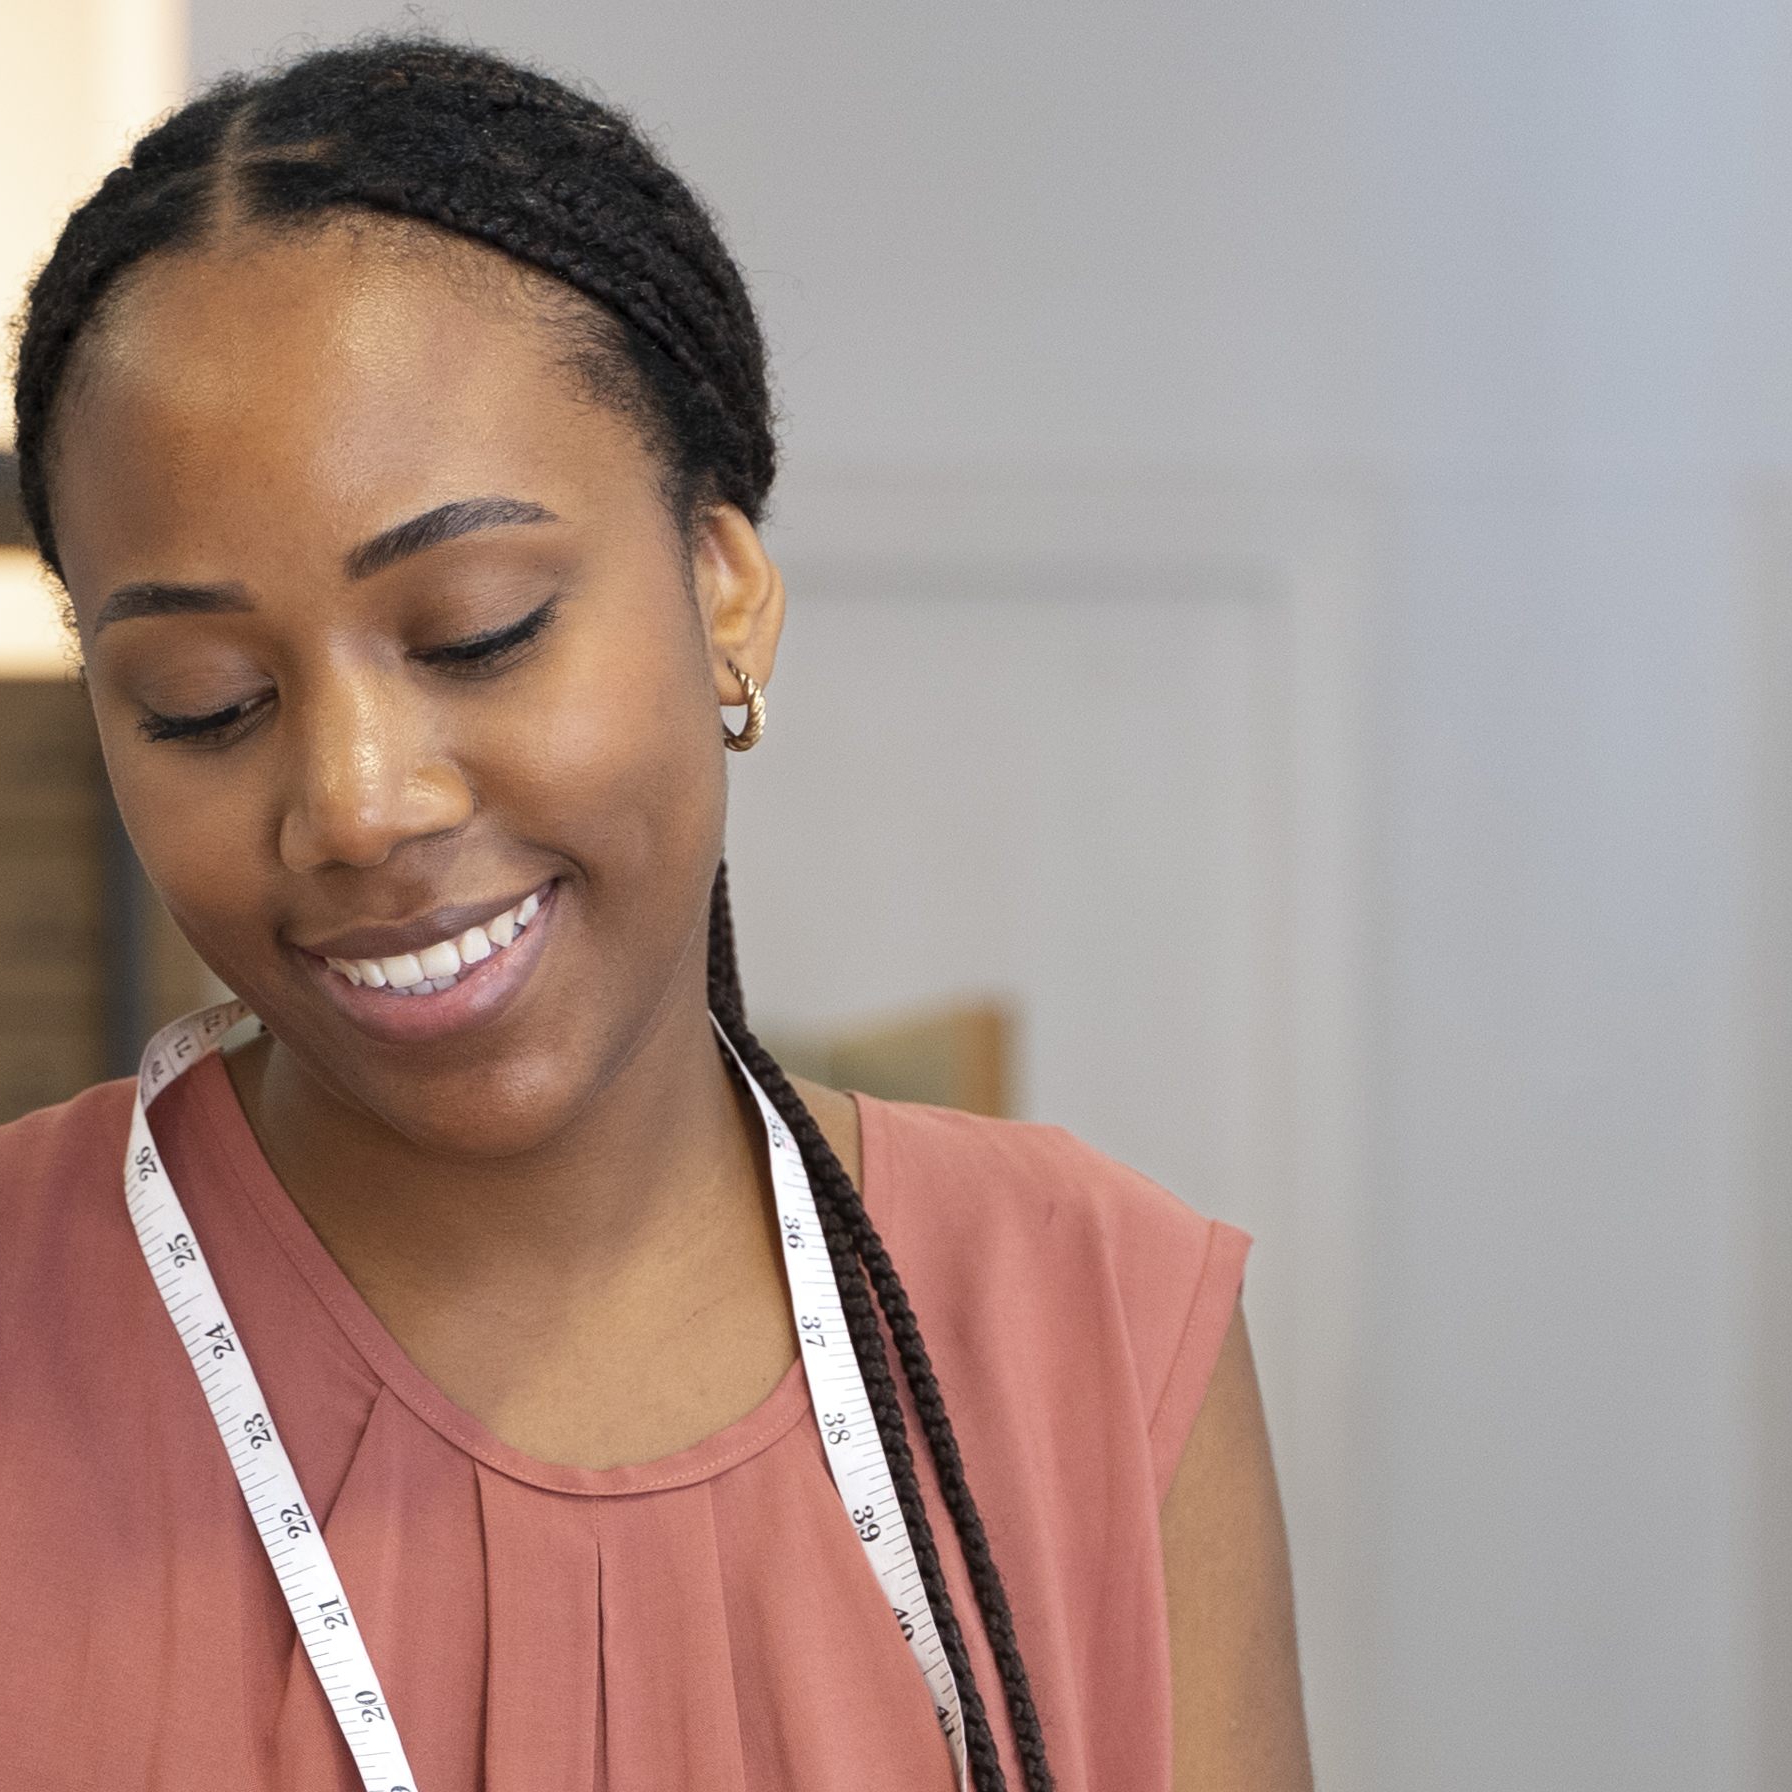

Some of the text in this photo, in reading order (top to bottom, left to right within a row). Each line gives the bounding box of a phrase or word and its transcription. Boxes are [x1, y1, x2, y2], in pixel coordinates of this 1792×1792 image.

[135, 1146, 157, 1182] 26
[168, 1232, 198, 1269] 25
[783, 1215, 805, 1250] 36
[205, 1321, 235, 1360] 24
[800, 1315, 827, 1348] 37
[244, 1412, 273, 1450] 23
[823, 1411, 852, 1446] 38
[280, 1502, 311, 1540] 22
[852, 1505, 882, 1543] 39
[318, 1594, 349, 1630] 21
[355, 1690, 385, 1725] 20
